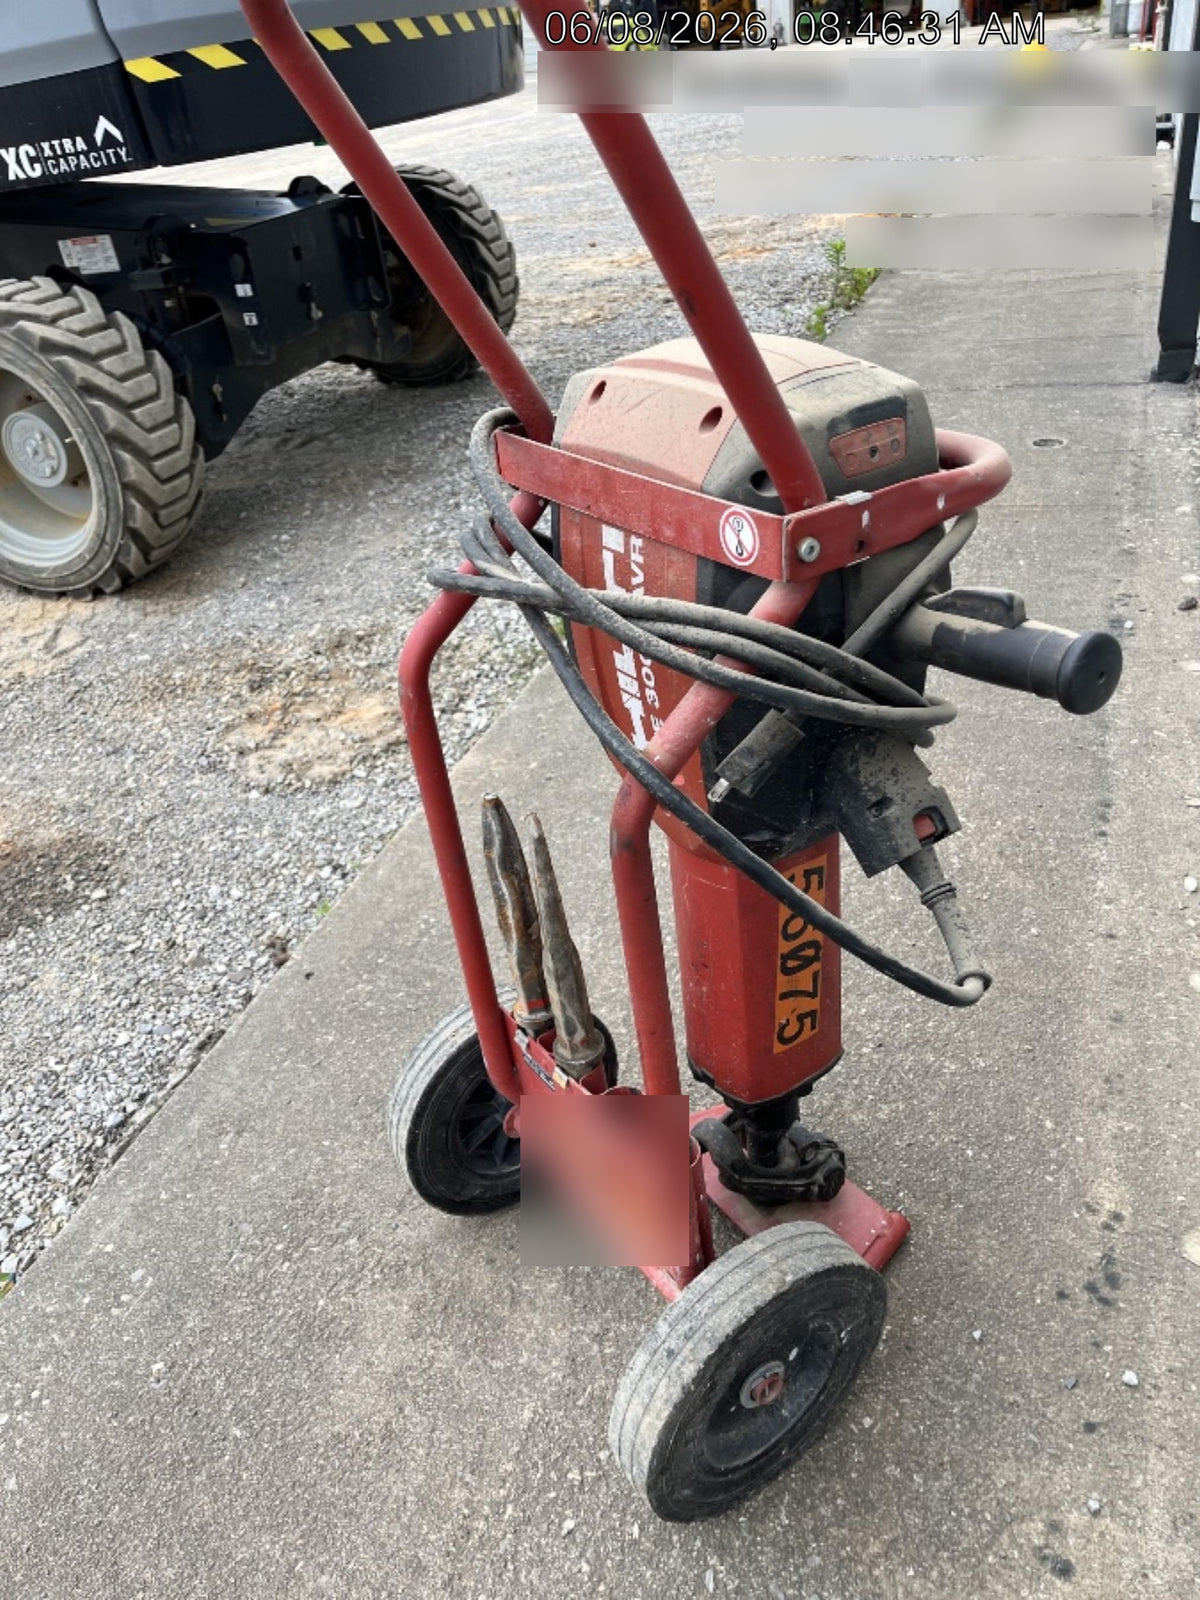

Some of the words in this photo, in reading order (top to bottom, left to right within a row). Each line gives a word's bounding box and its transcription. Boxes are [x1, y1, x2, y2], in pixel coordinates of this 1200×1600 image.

[40, 136, 88, 157] XTRA
[0, 144, 42, 180] XC
[47, 147, 128, 175] CAPACITY
